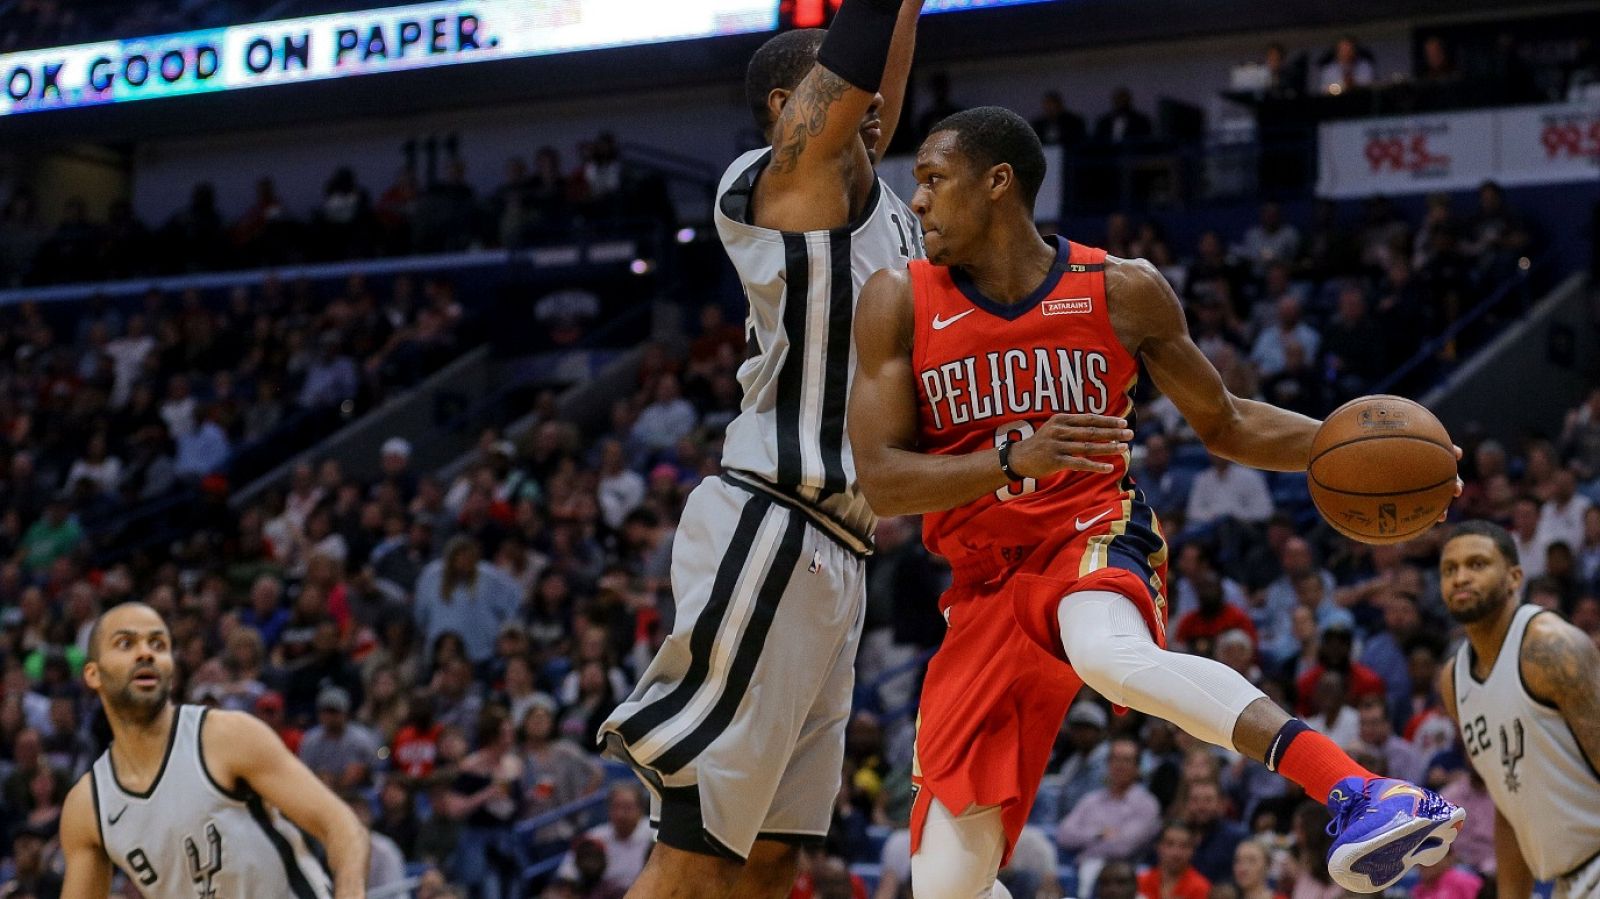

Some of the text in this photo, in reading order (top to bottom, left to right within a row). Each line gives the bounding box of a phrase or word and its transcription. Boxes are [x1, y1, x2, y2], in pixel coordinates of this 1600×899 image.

[89, 45, 218, 93] GOOD
[246, 34, 310, 75] ON
[335, 14, 499, 67] PAPER.
[1070, 264, 1086, 272] TB
[921, 348, 1108, 429] PELICANS
[1464, 715, 1492, 756] 22
[126, 848, 158, 886] 9
